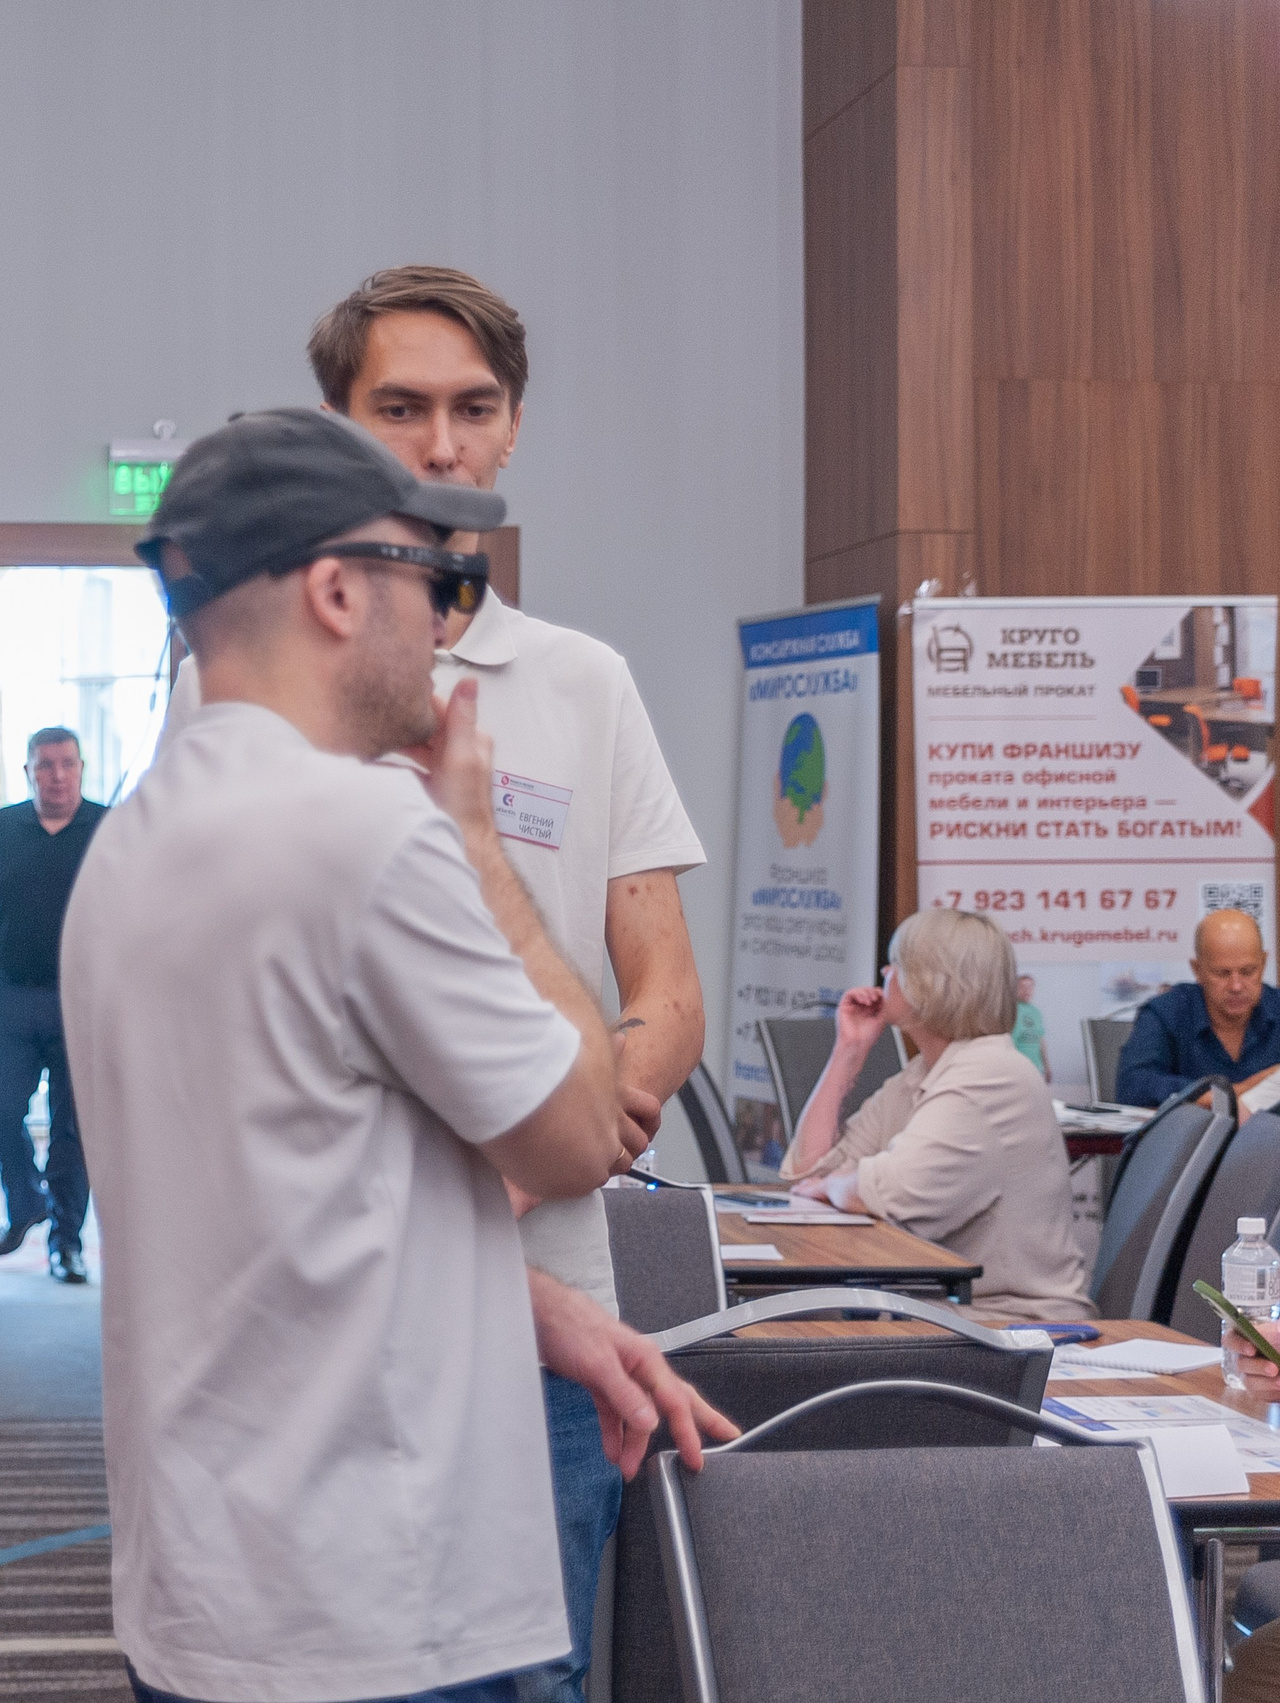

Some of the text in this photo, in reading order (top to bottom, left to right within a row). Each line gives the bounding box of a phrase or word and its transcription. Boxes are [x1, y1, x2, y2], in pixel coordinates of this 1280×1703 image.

[1001, 627, 1080, 647] КРУГО
[987, 652, 1096, 669] МЕБЕЛЬ
[927, 683, 1096, 698] МЕБЕЛЬНЫЙ ПРОКАТ
[927, 742, 1141, 761] КУПИ ФРАНШИЗУ
[928, 767, 1116, 788] проката офисной
[929, 795, 1009, 810] мебели
[1017, 797, 1028, 810] и
[1037, 796, 1147, 813] интерьера
[519, 812, 554, 828] ЕВГЕНИЙ
[929, 820, 1242, 839] РИСКНИ СТАТЬ БОГАТЫМ!
[518, 824, 552, 839] ЧИСТЫЙ
[974, 889, 1026, 911] 923
[1037, 889, 1088, 911] 141
[1099, 889, 1133, 911] 67
[1144, 889, 1177, 911] 67
[1007, 927, 1178, 947] ch.krugomebel.ru
